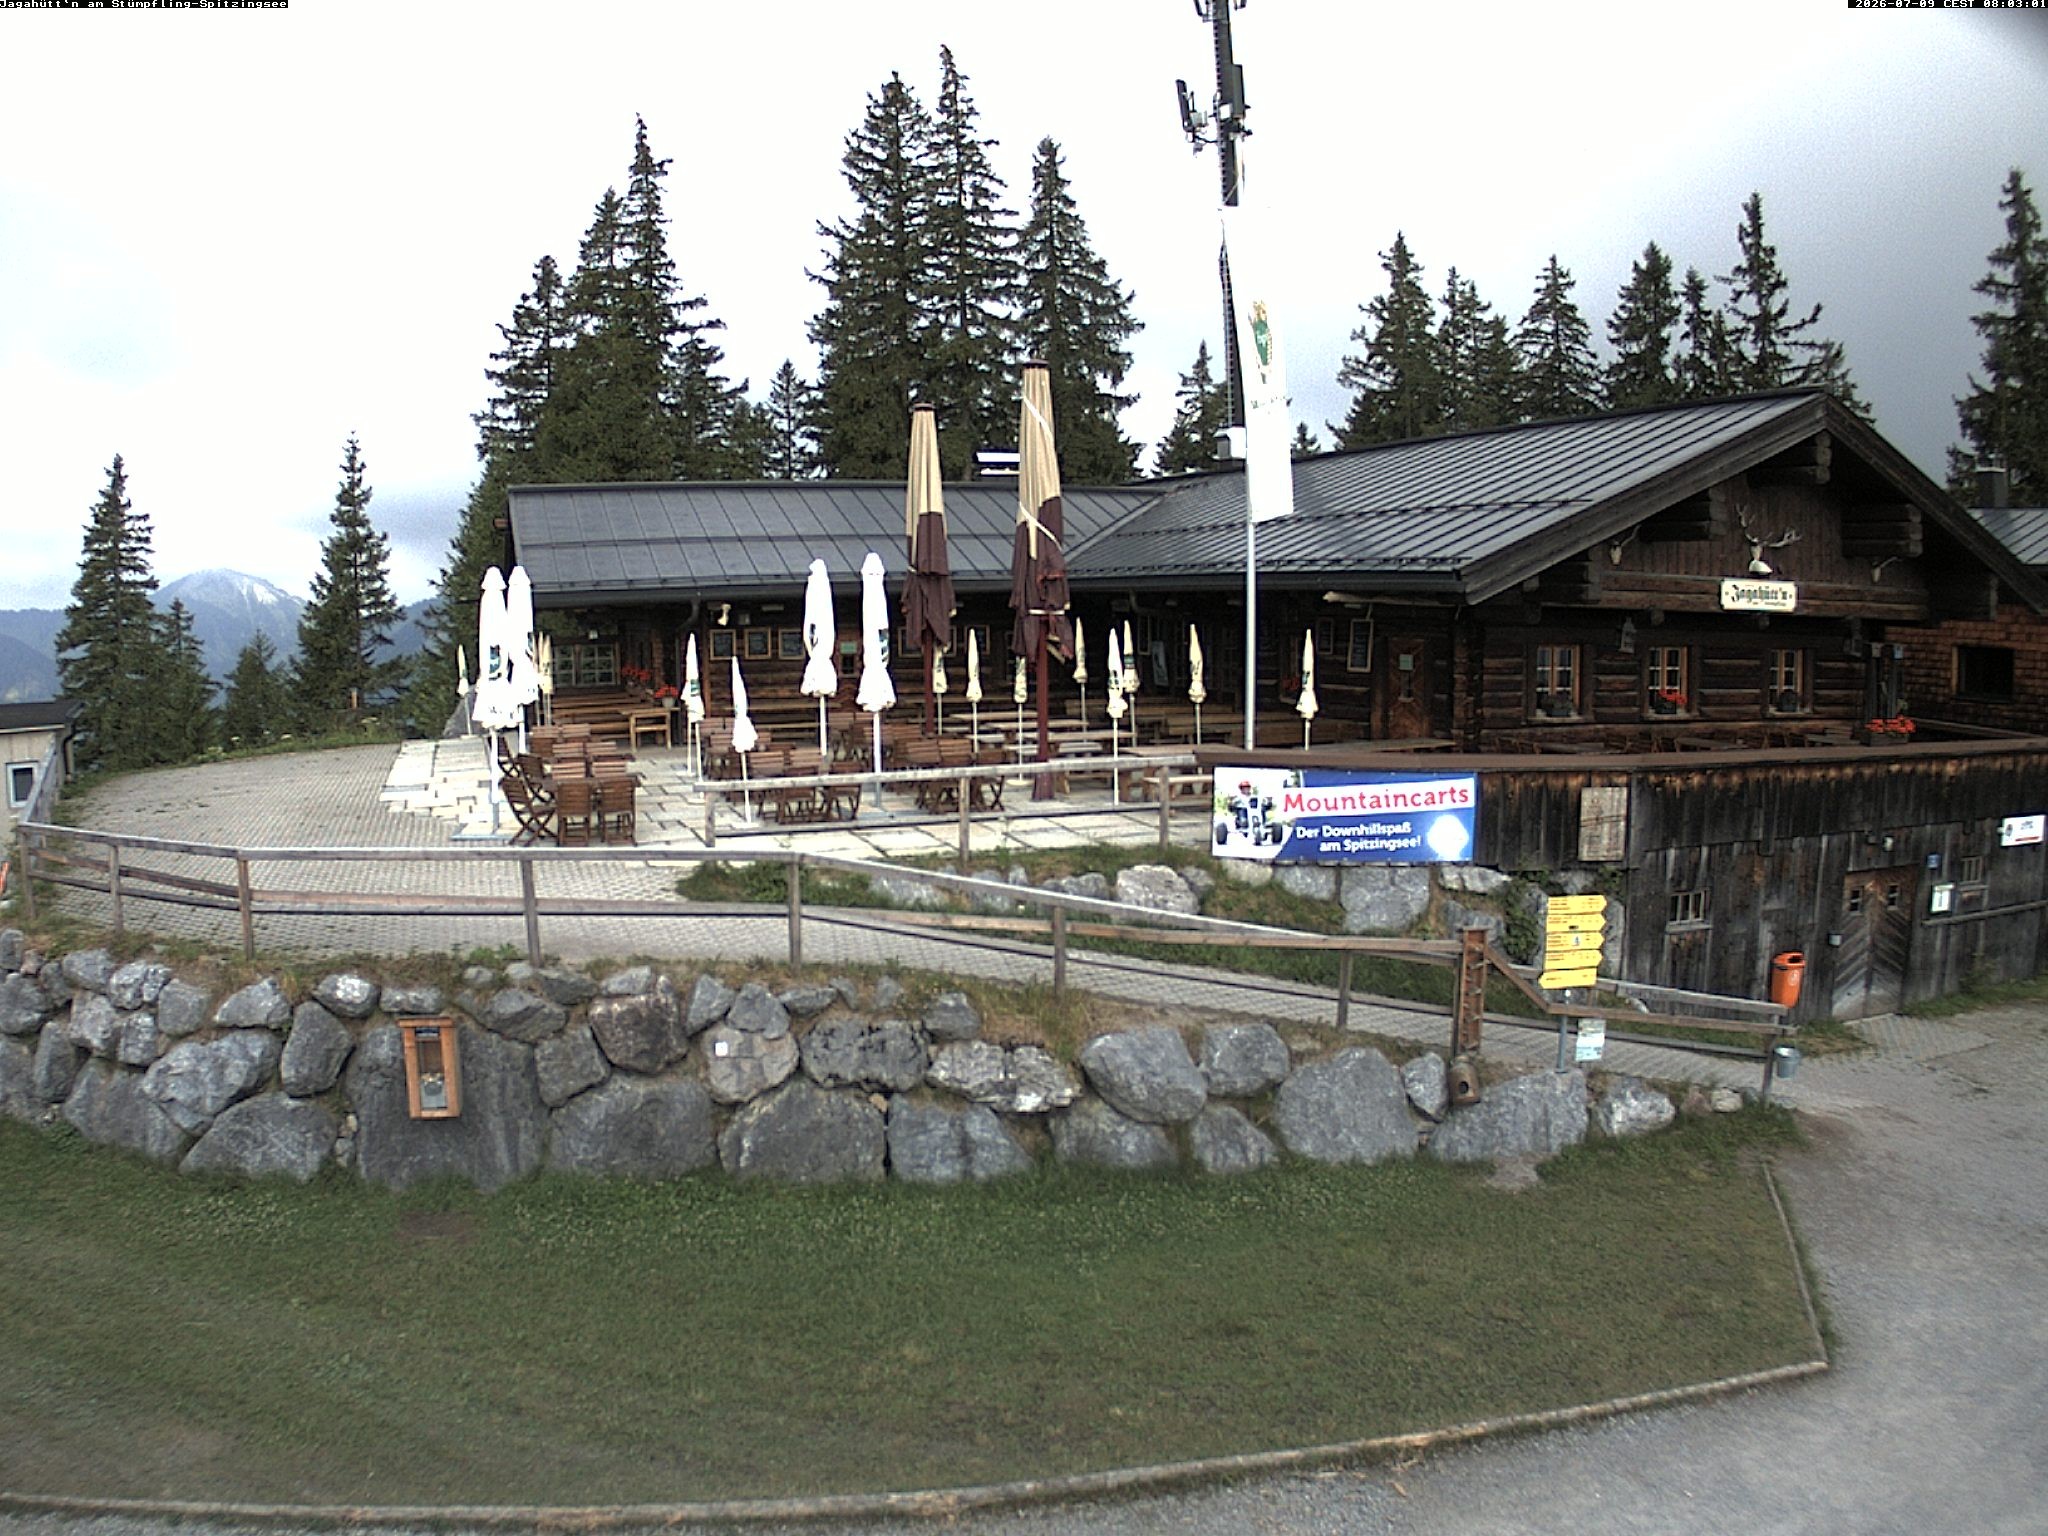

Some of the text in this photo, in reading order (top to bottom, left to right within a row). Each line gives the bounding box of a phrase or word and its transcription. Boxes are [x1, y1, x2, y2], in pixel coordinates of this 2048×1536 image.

[1283, 786, 1469, 812] Mountaincarts
[1296, 822, 1411, 838] Der Downhillspaß
[1319, 835, 1421, 854] am Spitzingsee!
